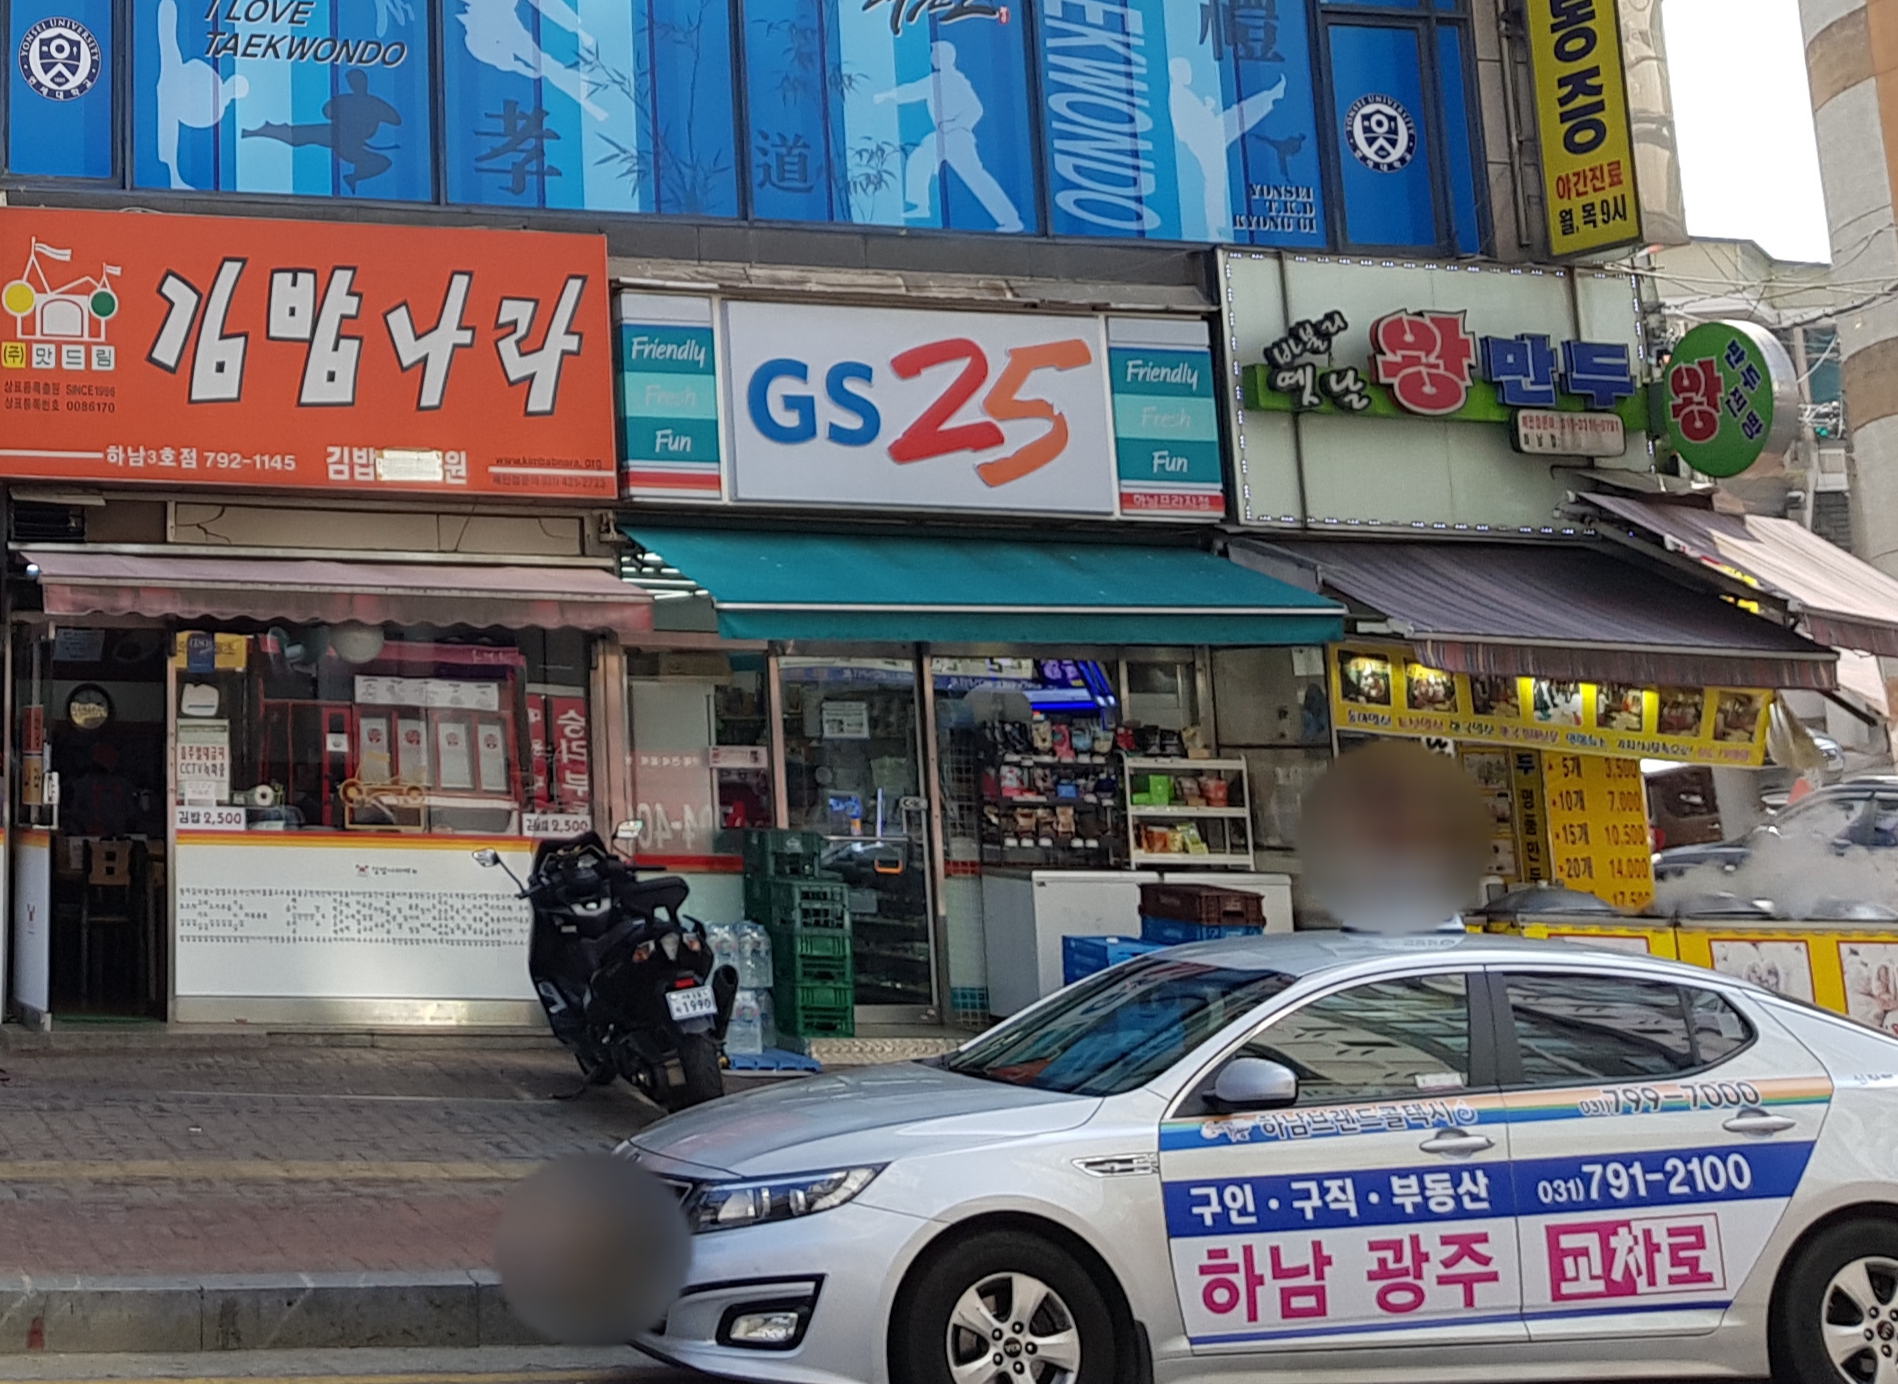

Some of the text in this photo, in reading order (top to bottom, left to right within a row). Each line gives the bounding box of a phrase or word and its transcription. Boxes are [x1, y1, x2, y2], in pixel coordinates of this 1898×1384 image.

[204, 32, 408, 68] TAEKWONDO
[1555, 159, 1625, 202] 야간진료
[146, 256, 588, 417] 김밥나라
[630, 335, 706, 368] Friendly
[1125, 359, 1200, 391] Friendly
[746, 337, 1092, 487] GS25
[654, 428, 692, 454] Fun
[105, 443, 199, 470] 하남3호점
[204, 449, 297, 472] 792-1145
[325, 444, 376, 483] 김밥
[1151, 449, 1189, 474] Fun
[203, 811, 243, 825] 2,500
[550, 819, 589, 833] 2,500
[1536, 1152, 1753, 1206] 031)791-2100
[1198, 1221, 1717, 1323] 하남 광주 교차로
